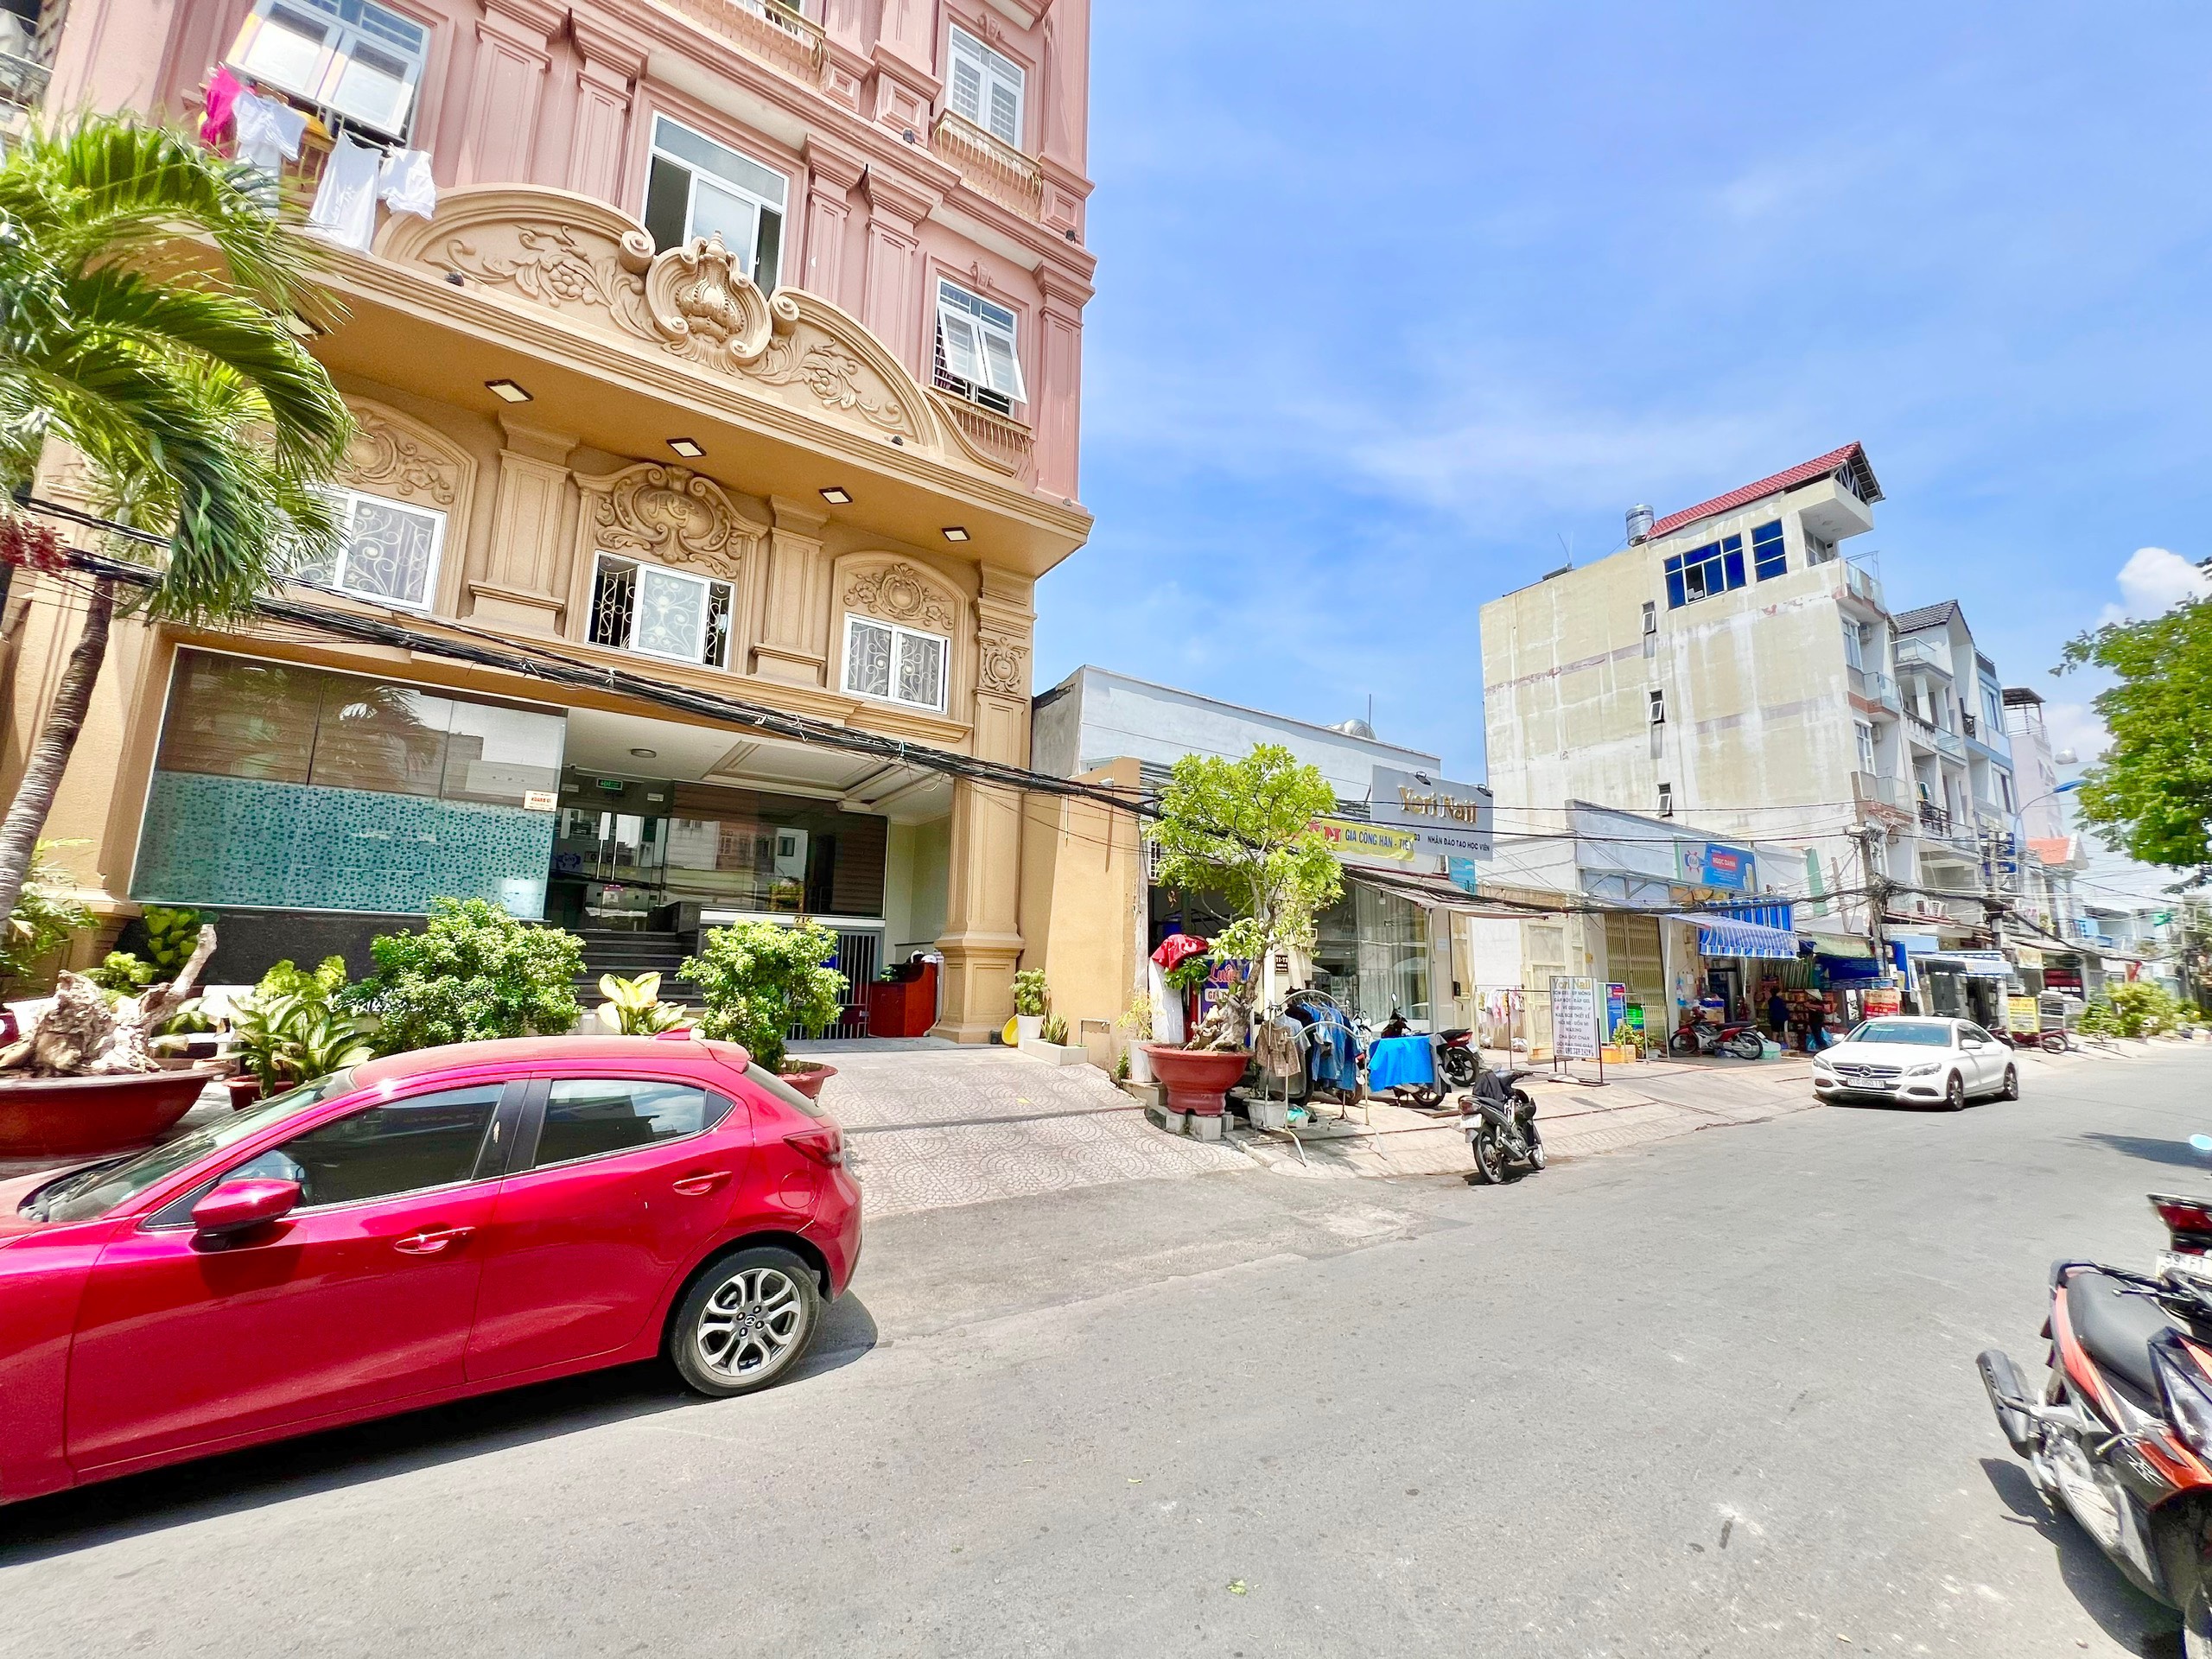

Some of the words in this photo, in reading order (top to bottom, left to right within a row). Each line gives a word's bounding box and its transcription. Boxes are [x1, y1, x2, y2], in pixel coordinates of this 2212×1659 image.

[1440, 793, 1478, 824] Nail
[1345, 829, 1357, 842] GIA
[1358, 829, 1377, 845] CÔNG
[1379, 832, 1393, 849] HÀN
[1573, 979, 1591, 989] Nail
